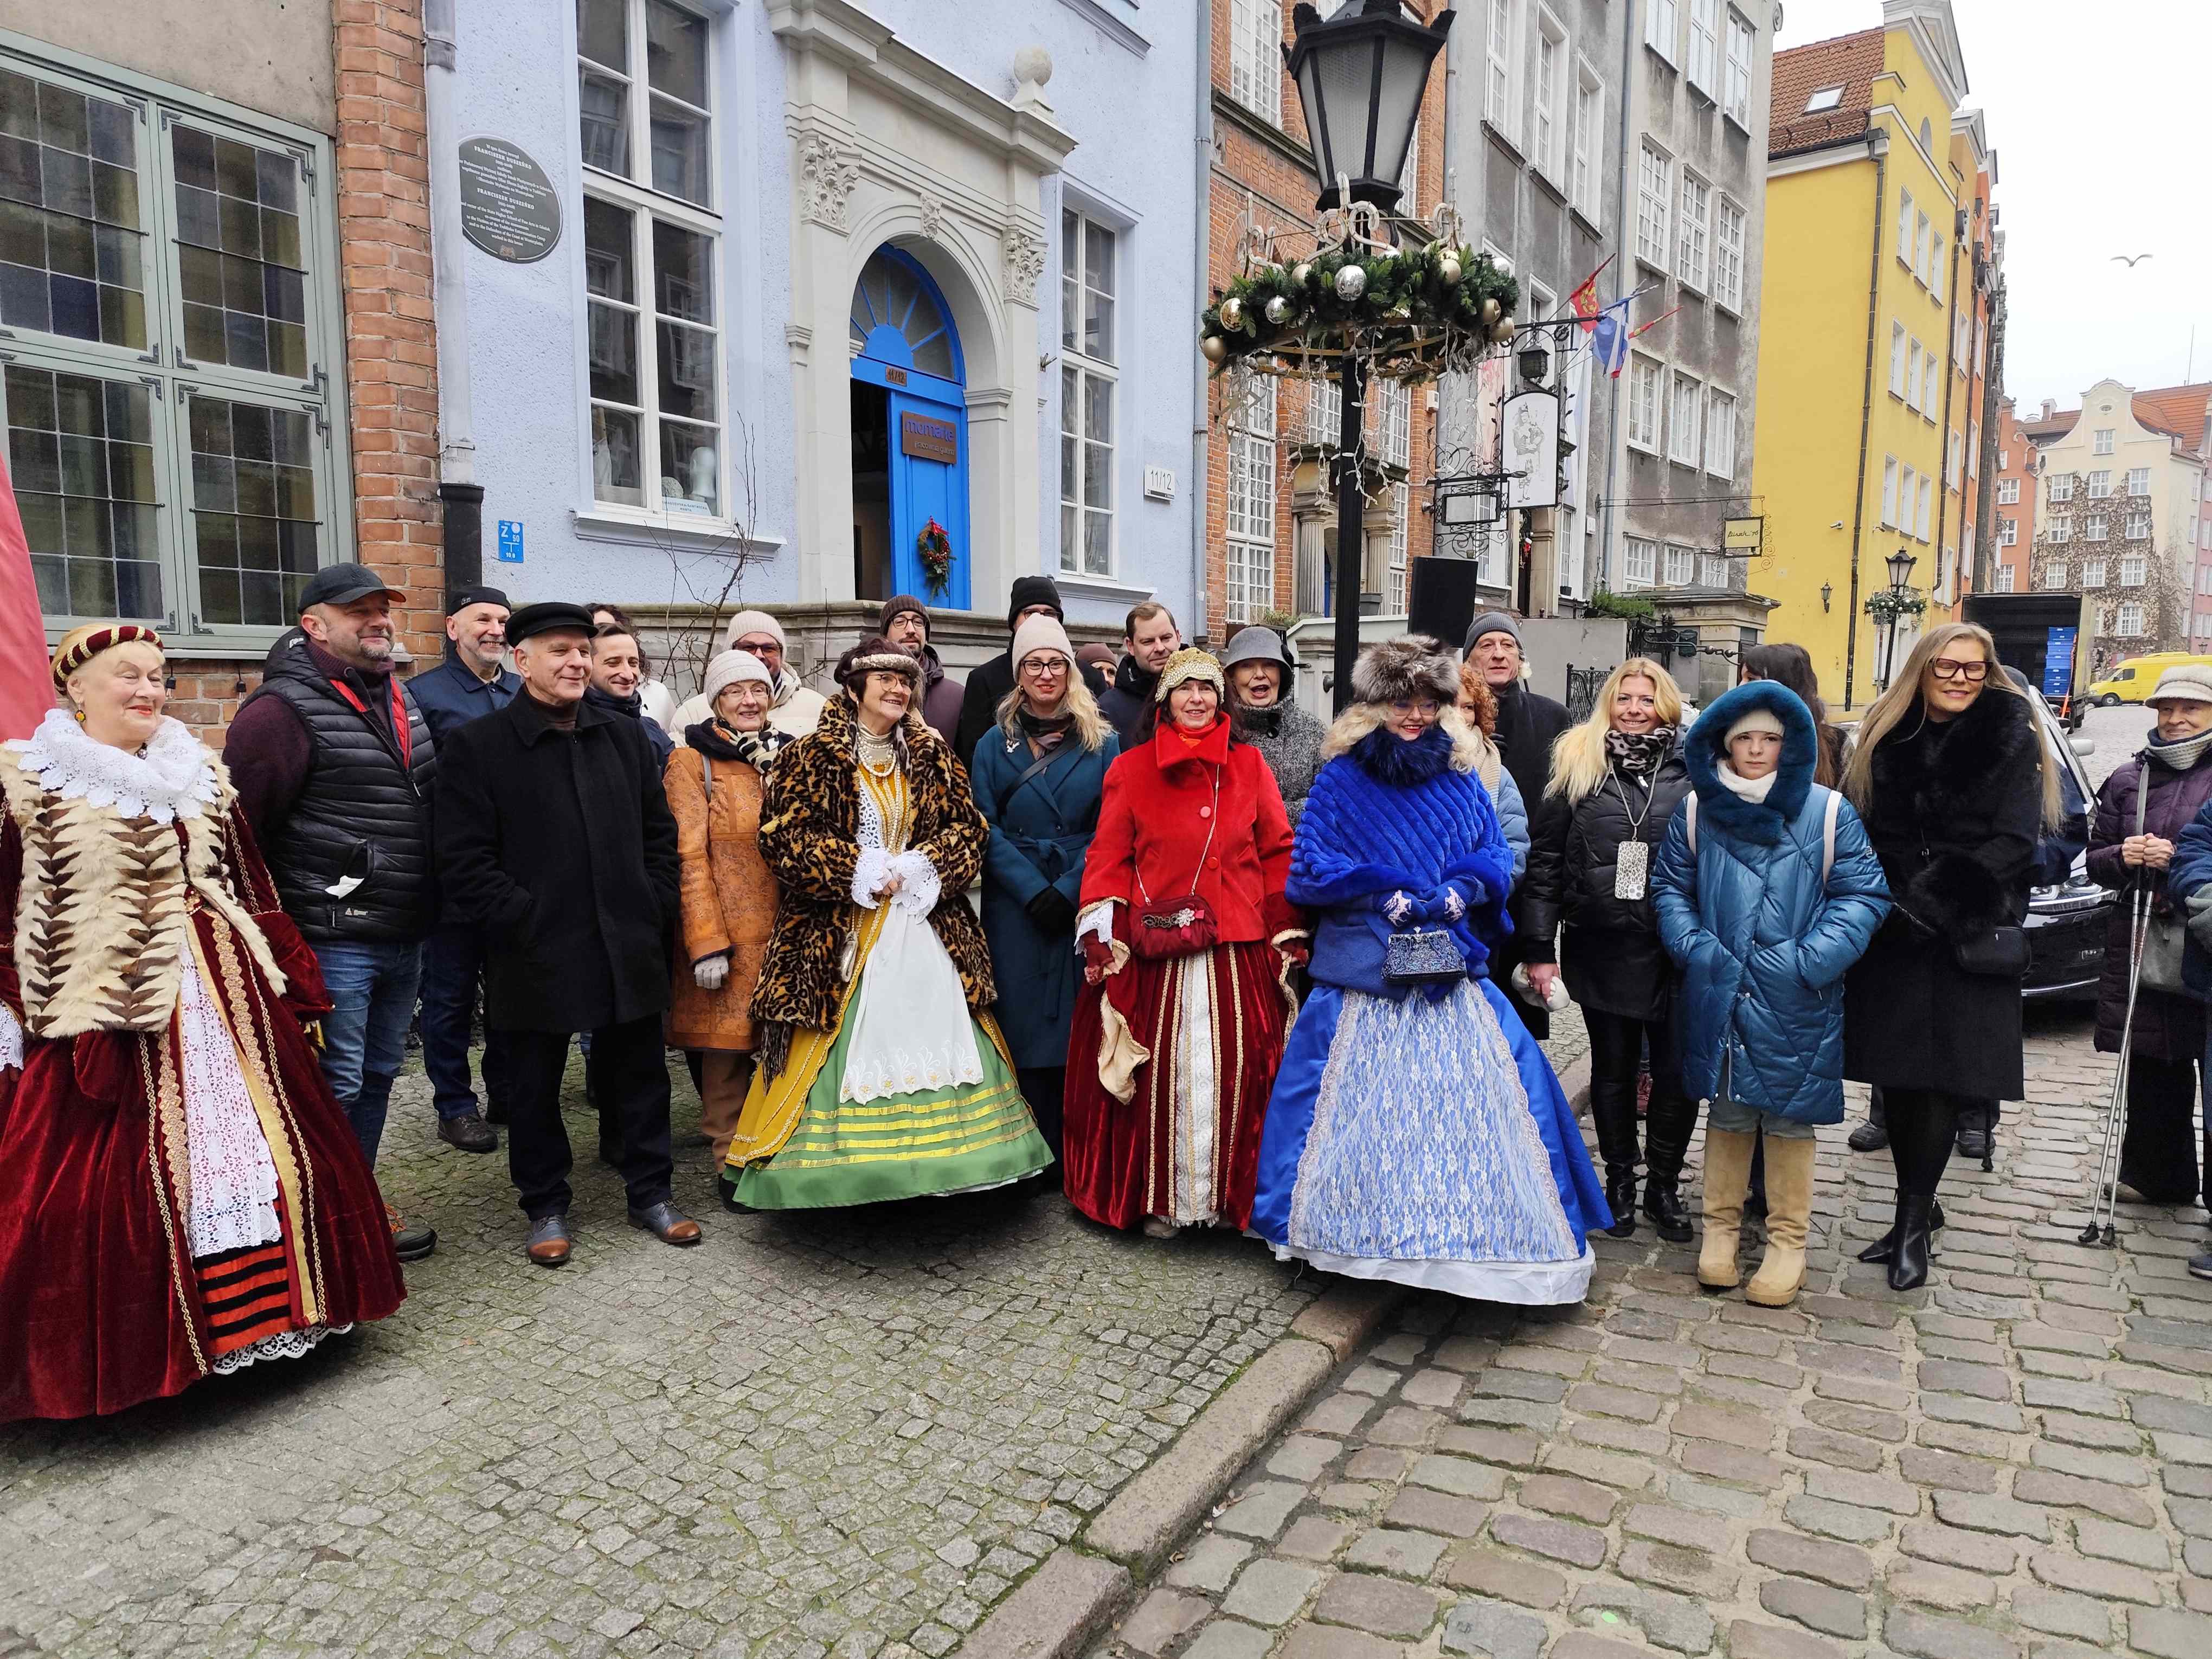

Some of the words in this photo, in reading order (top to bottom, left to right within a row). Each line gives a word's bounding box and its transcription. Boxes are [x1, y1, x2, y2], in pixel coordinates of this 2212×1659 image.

[474, 145, 505, 160] FRANCISZEK
[477, 187, 507, 202] FRANCISZEK
[1151, 469, 1171, 490] 11/12
[501, 526, 508, 537] Z
[512, 534, 520, 543] 50
